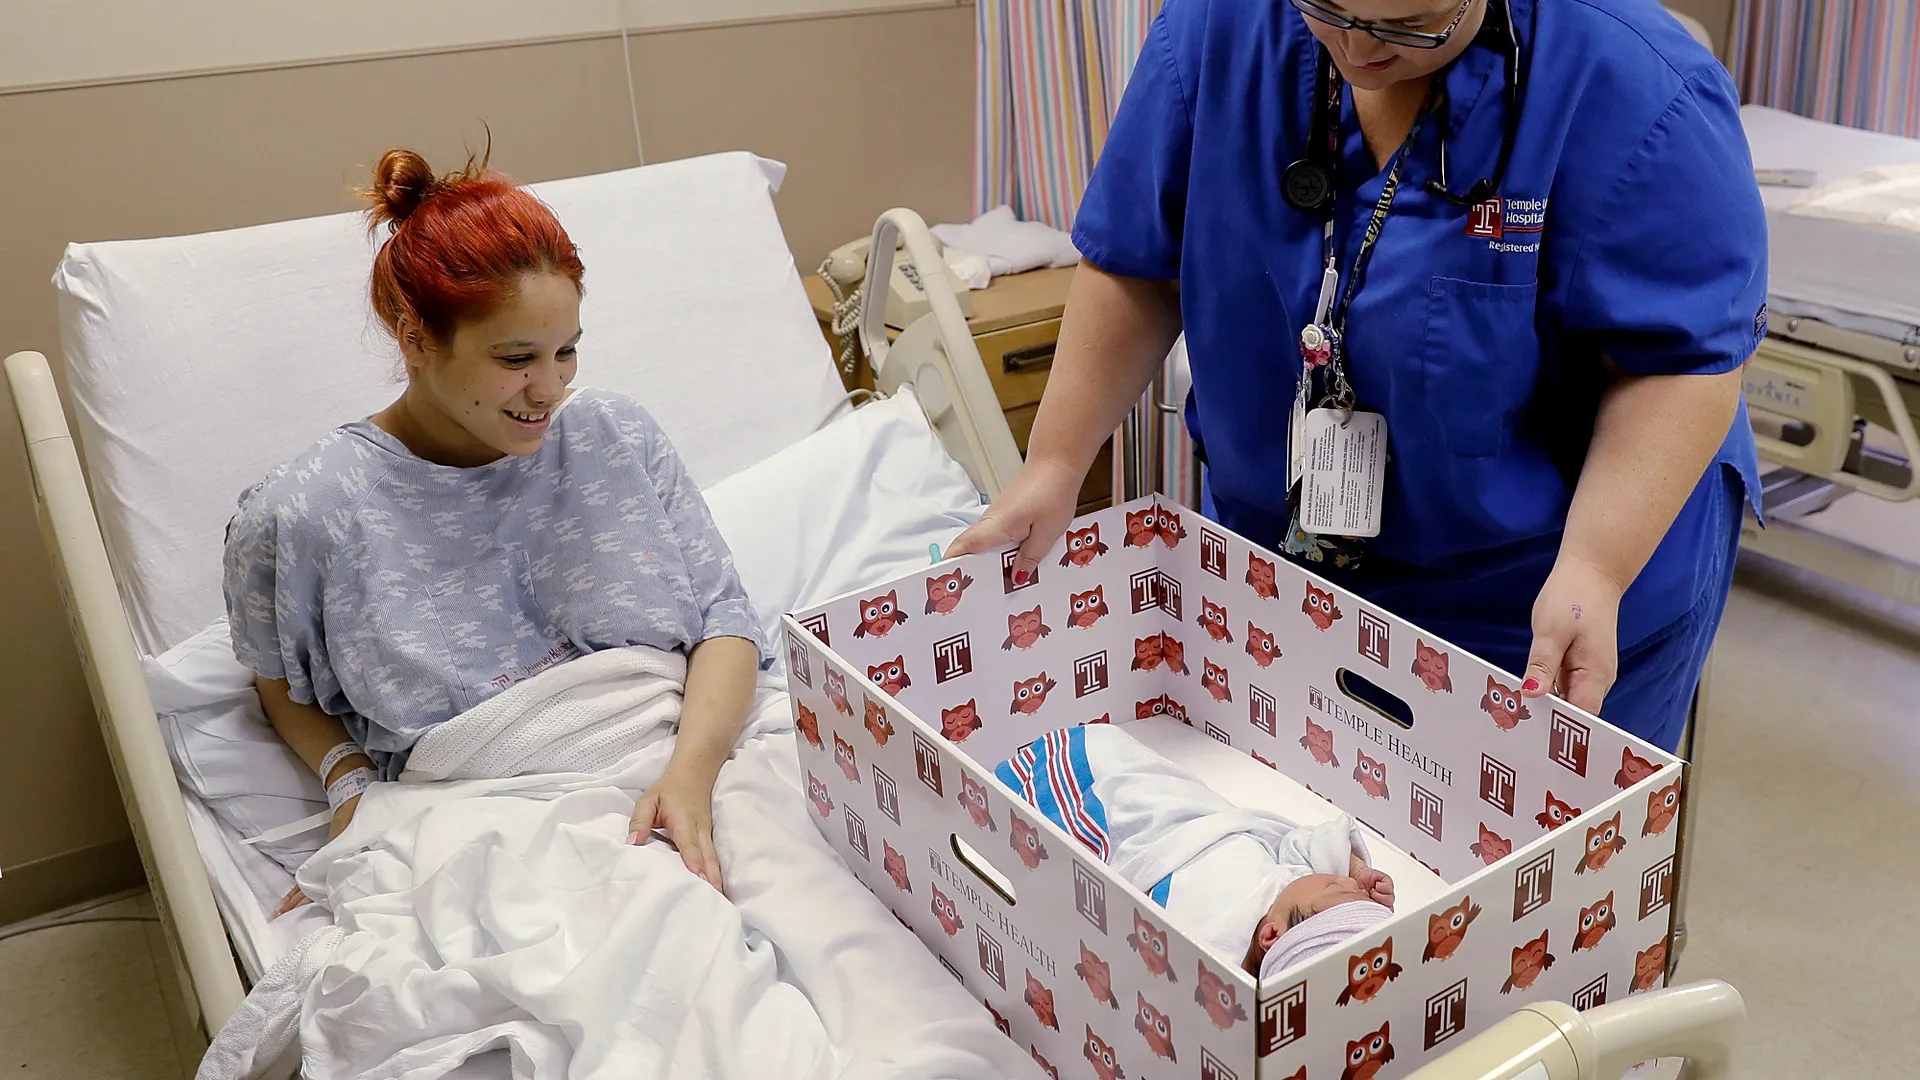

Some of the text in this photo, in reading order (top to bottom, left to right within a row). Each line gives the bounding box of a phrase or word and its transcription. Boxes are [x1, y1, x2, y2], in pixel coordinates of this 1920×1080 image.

[1505, 198, 1542, 212] Temple
[1489, 241, 1534, 253] Registered
[521, 655, 554, 675] University
[1324, 696, 1383, 746] TEMPLE
[1388, 733, 1453, 787] HEALTH
[942, 860, 995, 923] TEMPLE
[998, 911, 1057, 978] HEALTH
